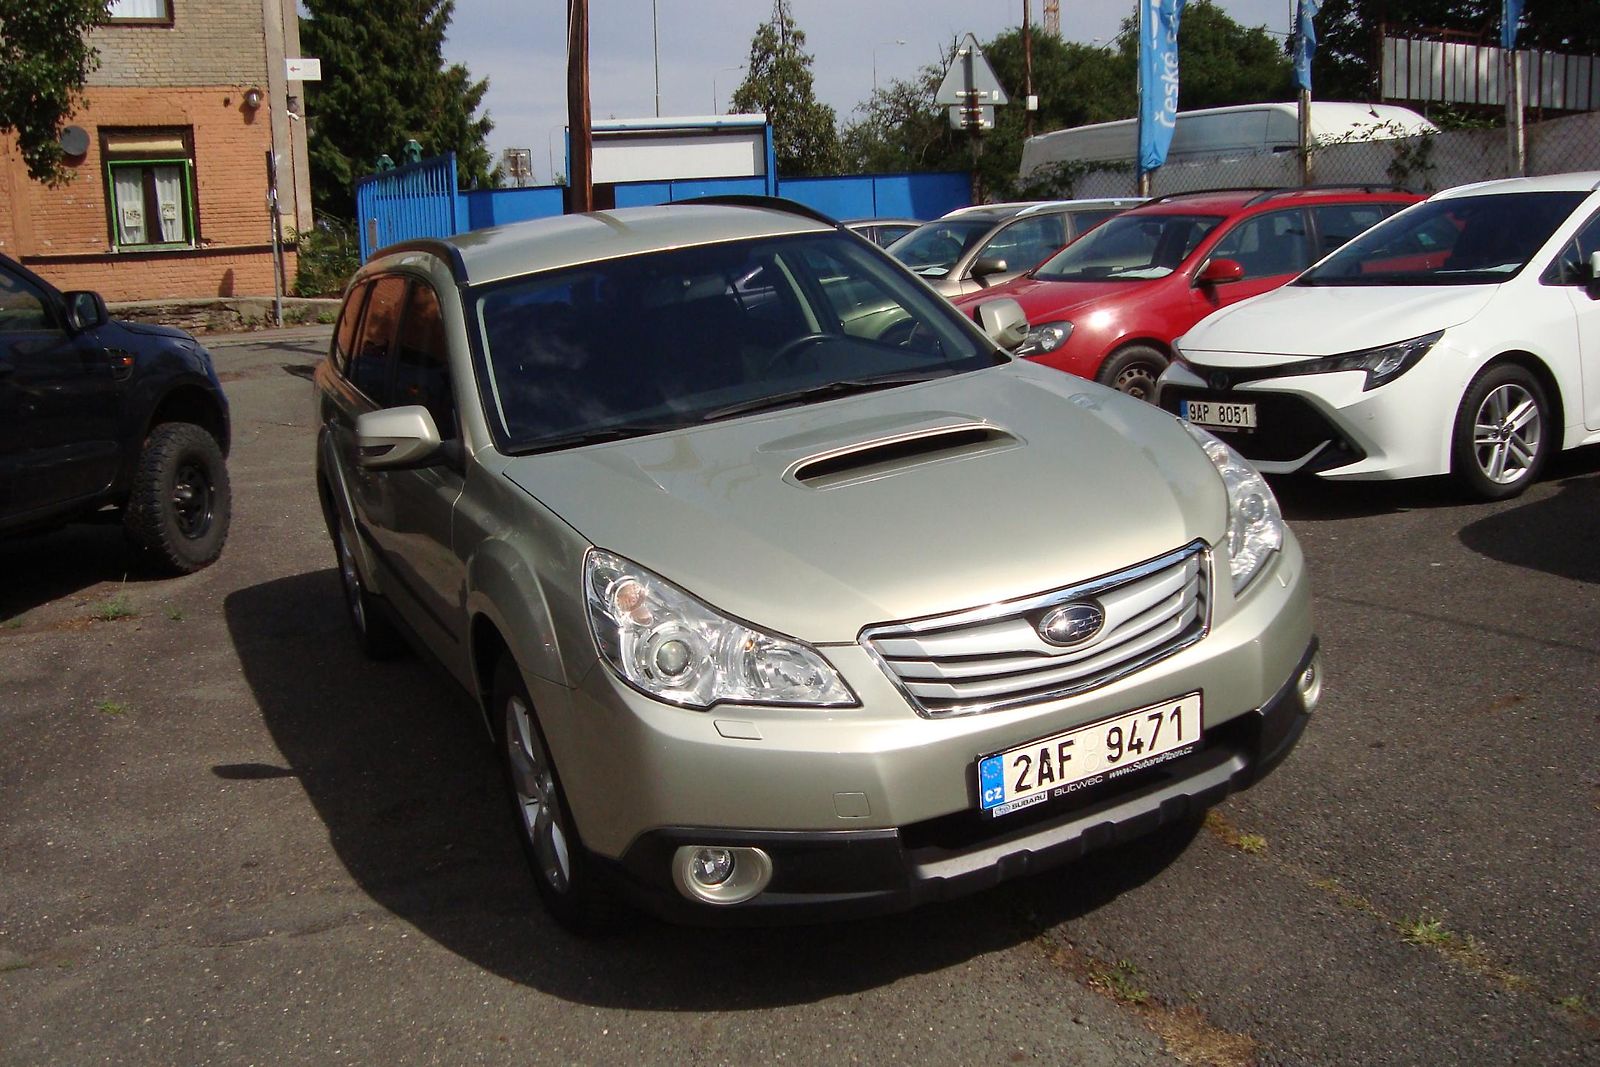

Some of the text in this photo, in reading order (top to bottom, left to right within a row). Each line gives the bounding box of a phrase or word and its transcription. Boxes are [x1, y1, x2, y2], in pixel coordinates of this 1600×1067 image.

[1189, 403, 1249, 424] 9AP 8051
[1013, 705, 1183, 793] 2AF 9471
[985, 787, 1002, 802] CZ
[1012, 793, 1046, 809] SUBARU
